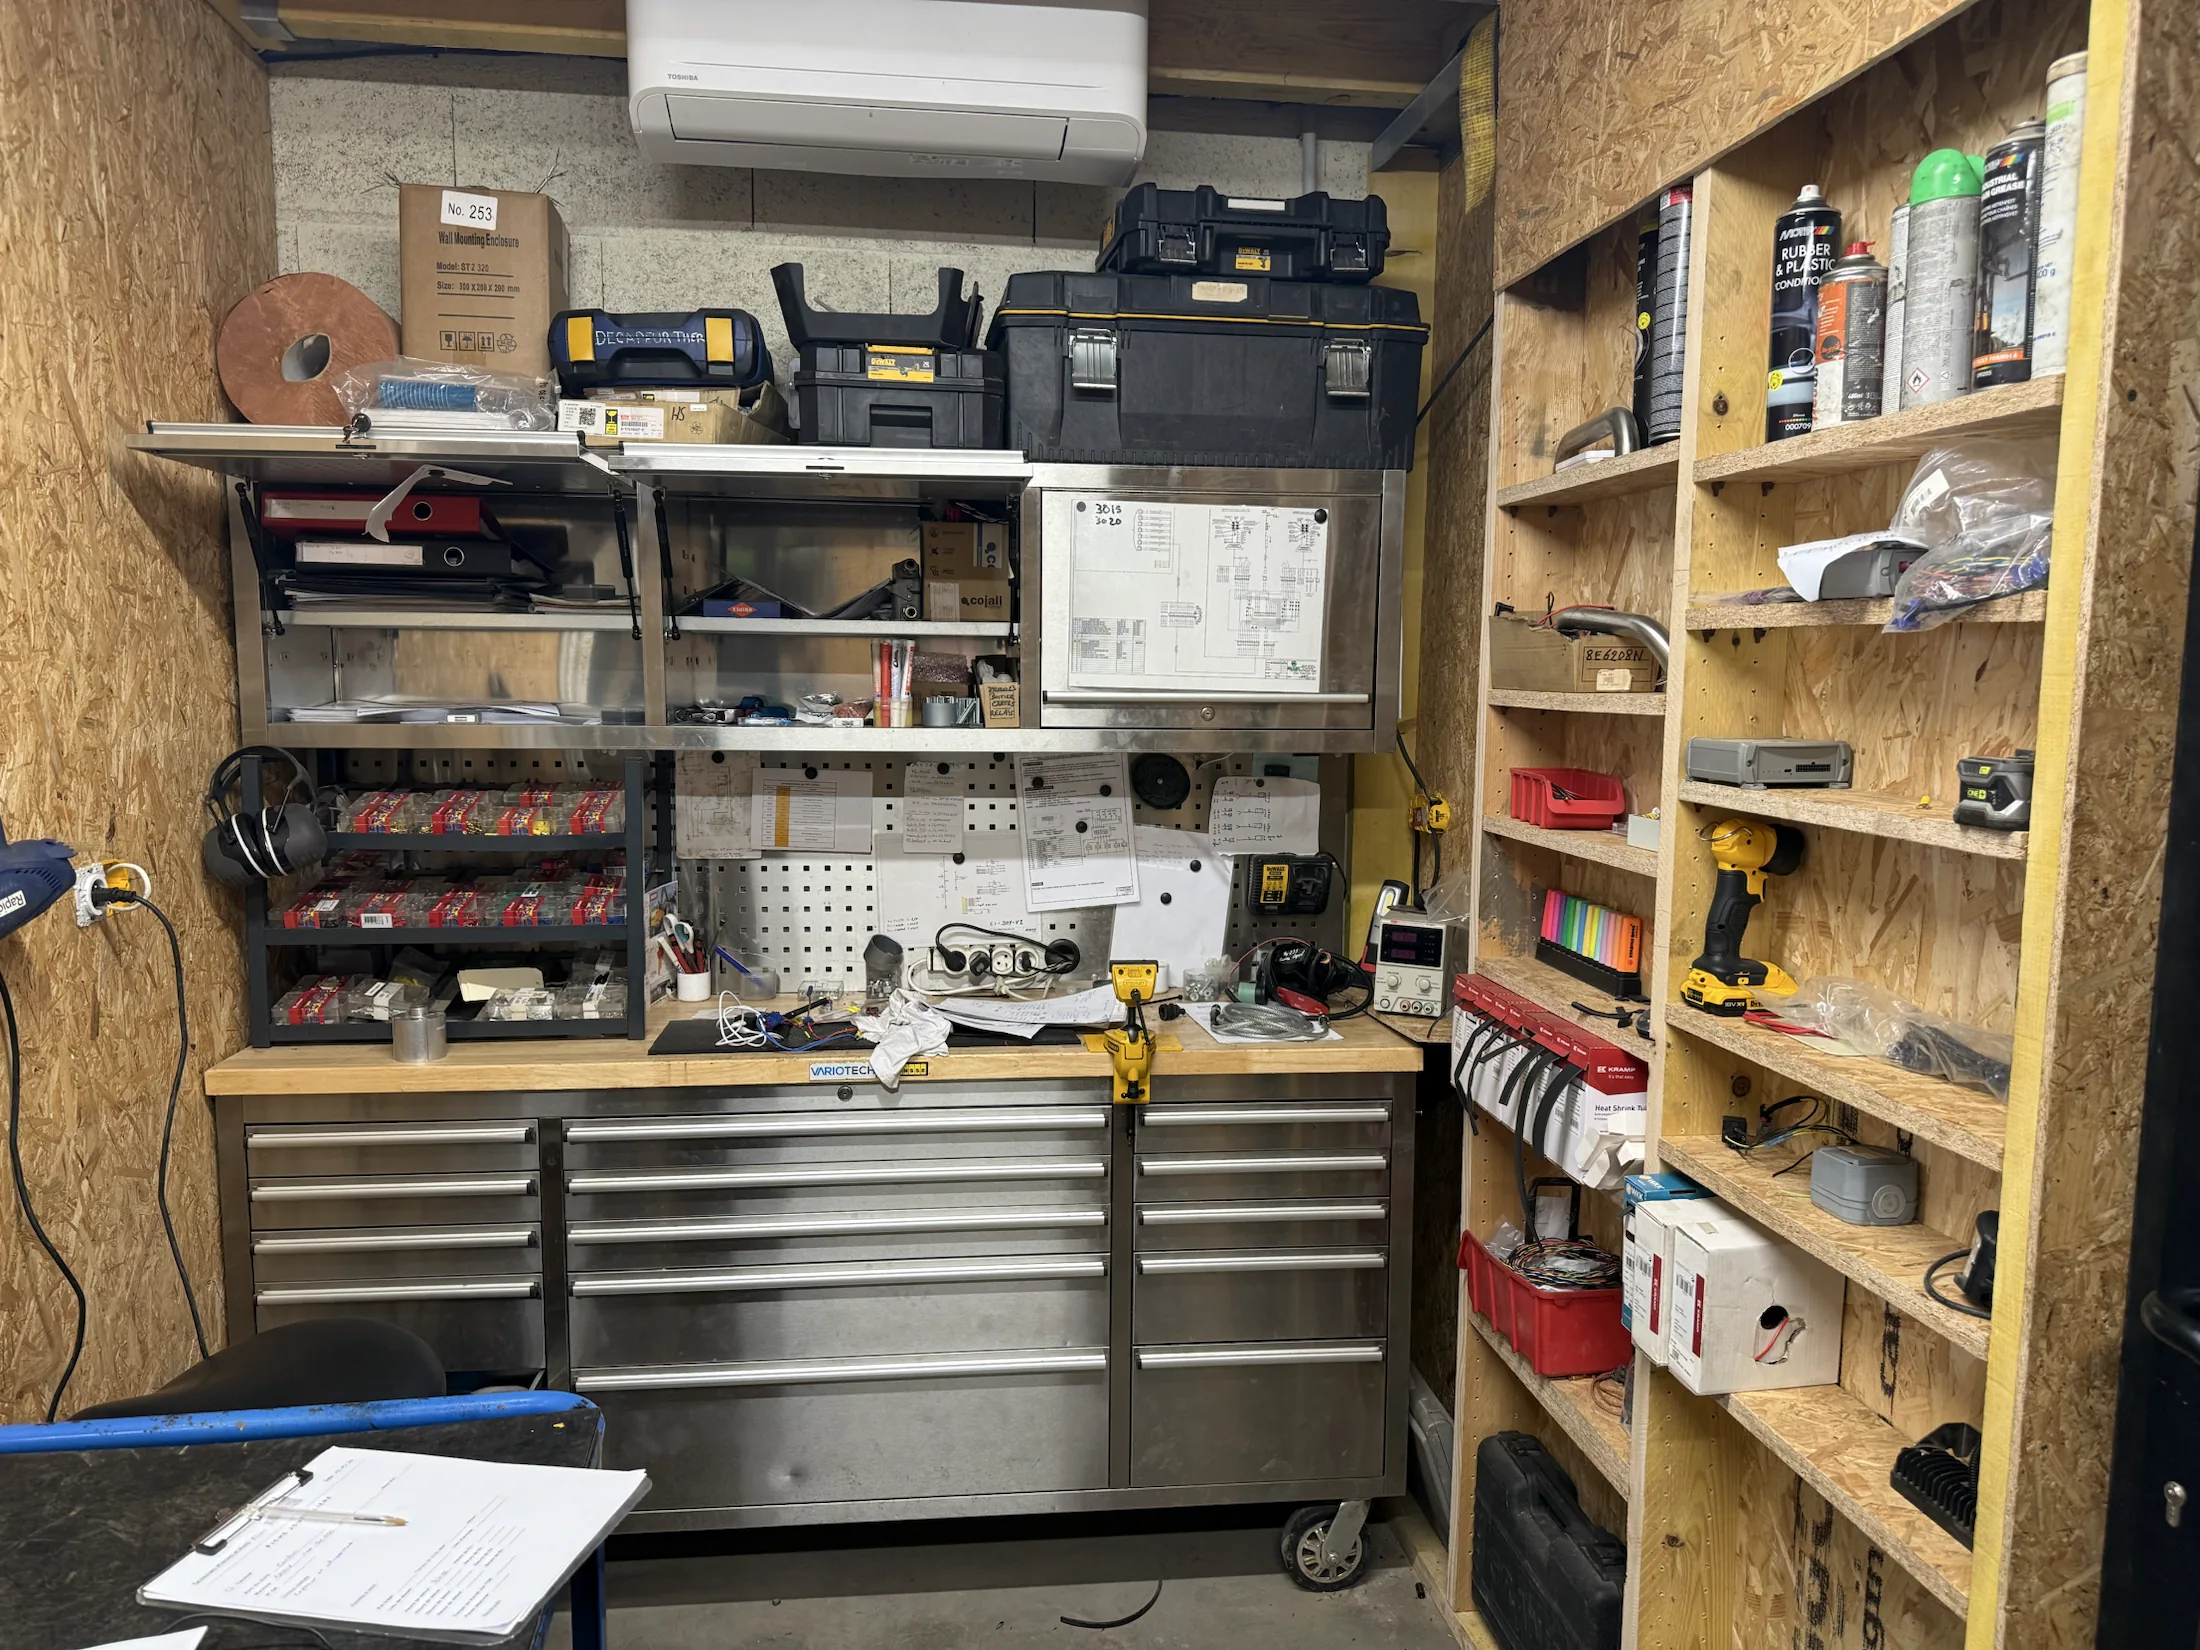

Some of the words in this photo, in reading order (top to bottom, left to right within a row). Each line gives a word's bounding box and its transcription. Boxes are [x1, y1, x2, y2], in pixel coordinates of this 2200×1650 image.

[667, 73, 699, 81] TOSHIBA
[1991, 181, 2025, 196] GREASE
[448, 202, 464, 216] No.
[469, 204, 492, 221] 253
[438, 231, 453, 244] Wall
[454, 232, 485, 249] Mounting
[486, 234, 520, 248] Enclosure
[1781, 243, 1831, 260] RUBBER
[436, 261, 460, 271] Model:
[1775, 263, 1784, 277] &
[1786, 258, 1836, 274] PLASTIC
[437, 280, 455, 290] Size:
[507, 285, 520, 293] mm
[1774, 276, 1822, 292] CONDITIO
[671, 406, 686, 422] HS
[1784, 422, 1813, 431] 000709
[970, 595, 1002, 608] cojali
[1586, 648, 1644, 662] 8E6208N
[810, 1065, 876, 1077] VARIOTECH
[1595, 1103, 1612, 1112] Heat
[1612, 1103, 1636, 1112] Shrink
